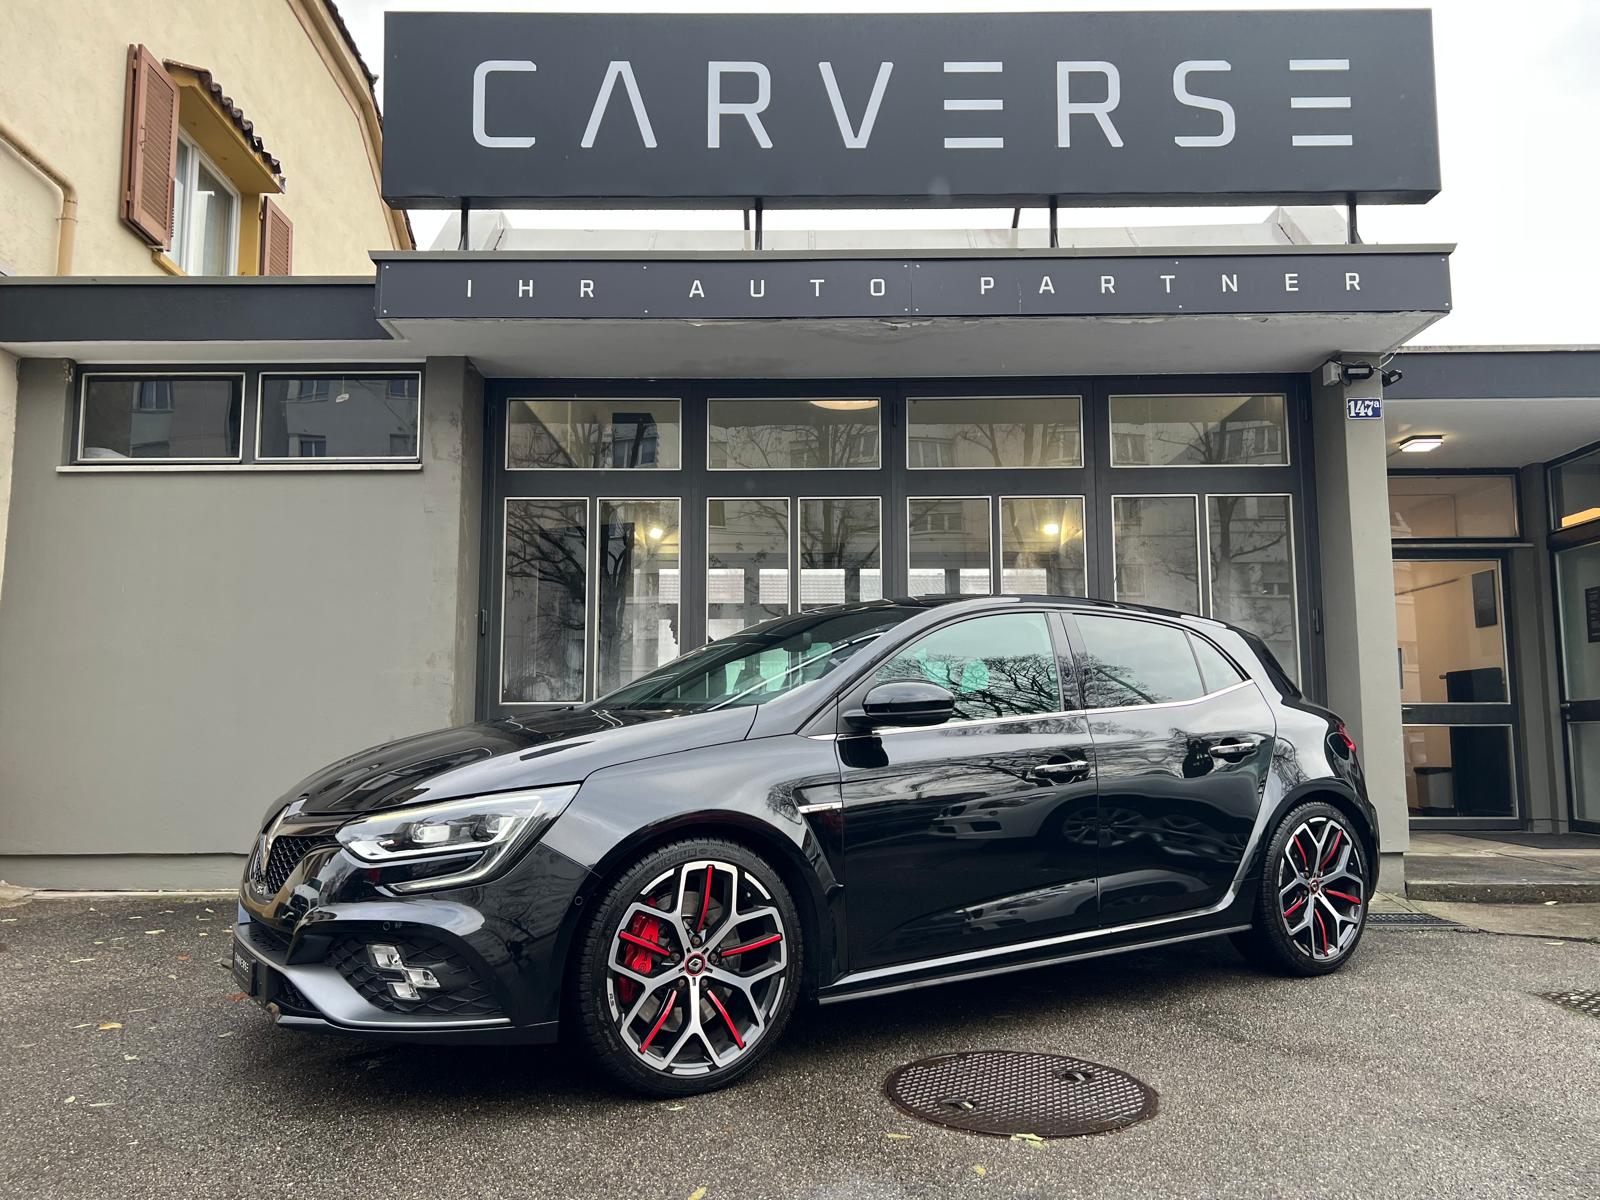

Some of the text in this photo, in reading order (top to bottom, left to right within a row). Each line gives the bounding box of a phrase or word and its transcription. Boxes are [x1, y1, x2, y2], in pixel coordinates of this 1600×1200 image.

[472, 58, 1354, 149] CARVERSE
[466, 271, 1362, 299] IHR AUTO PARTNER
[1348, 400, 1380, 417] 147a
